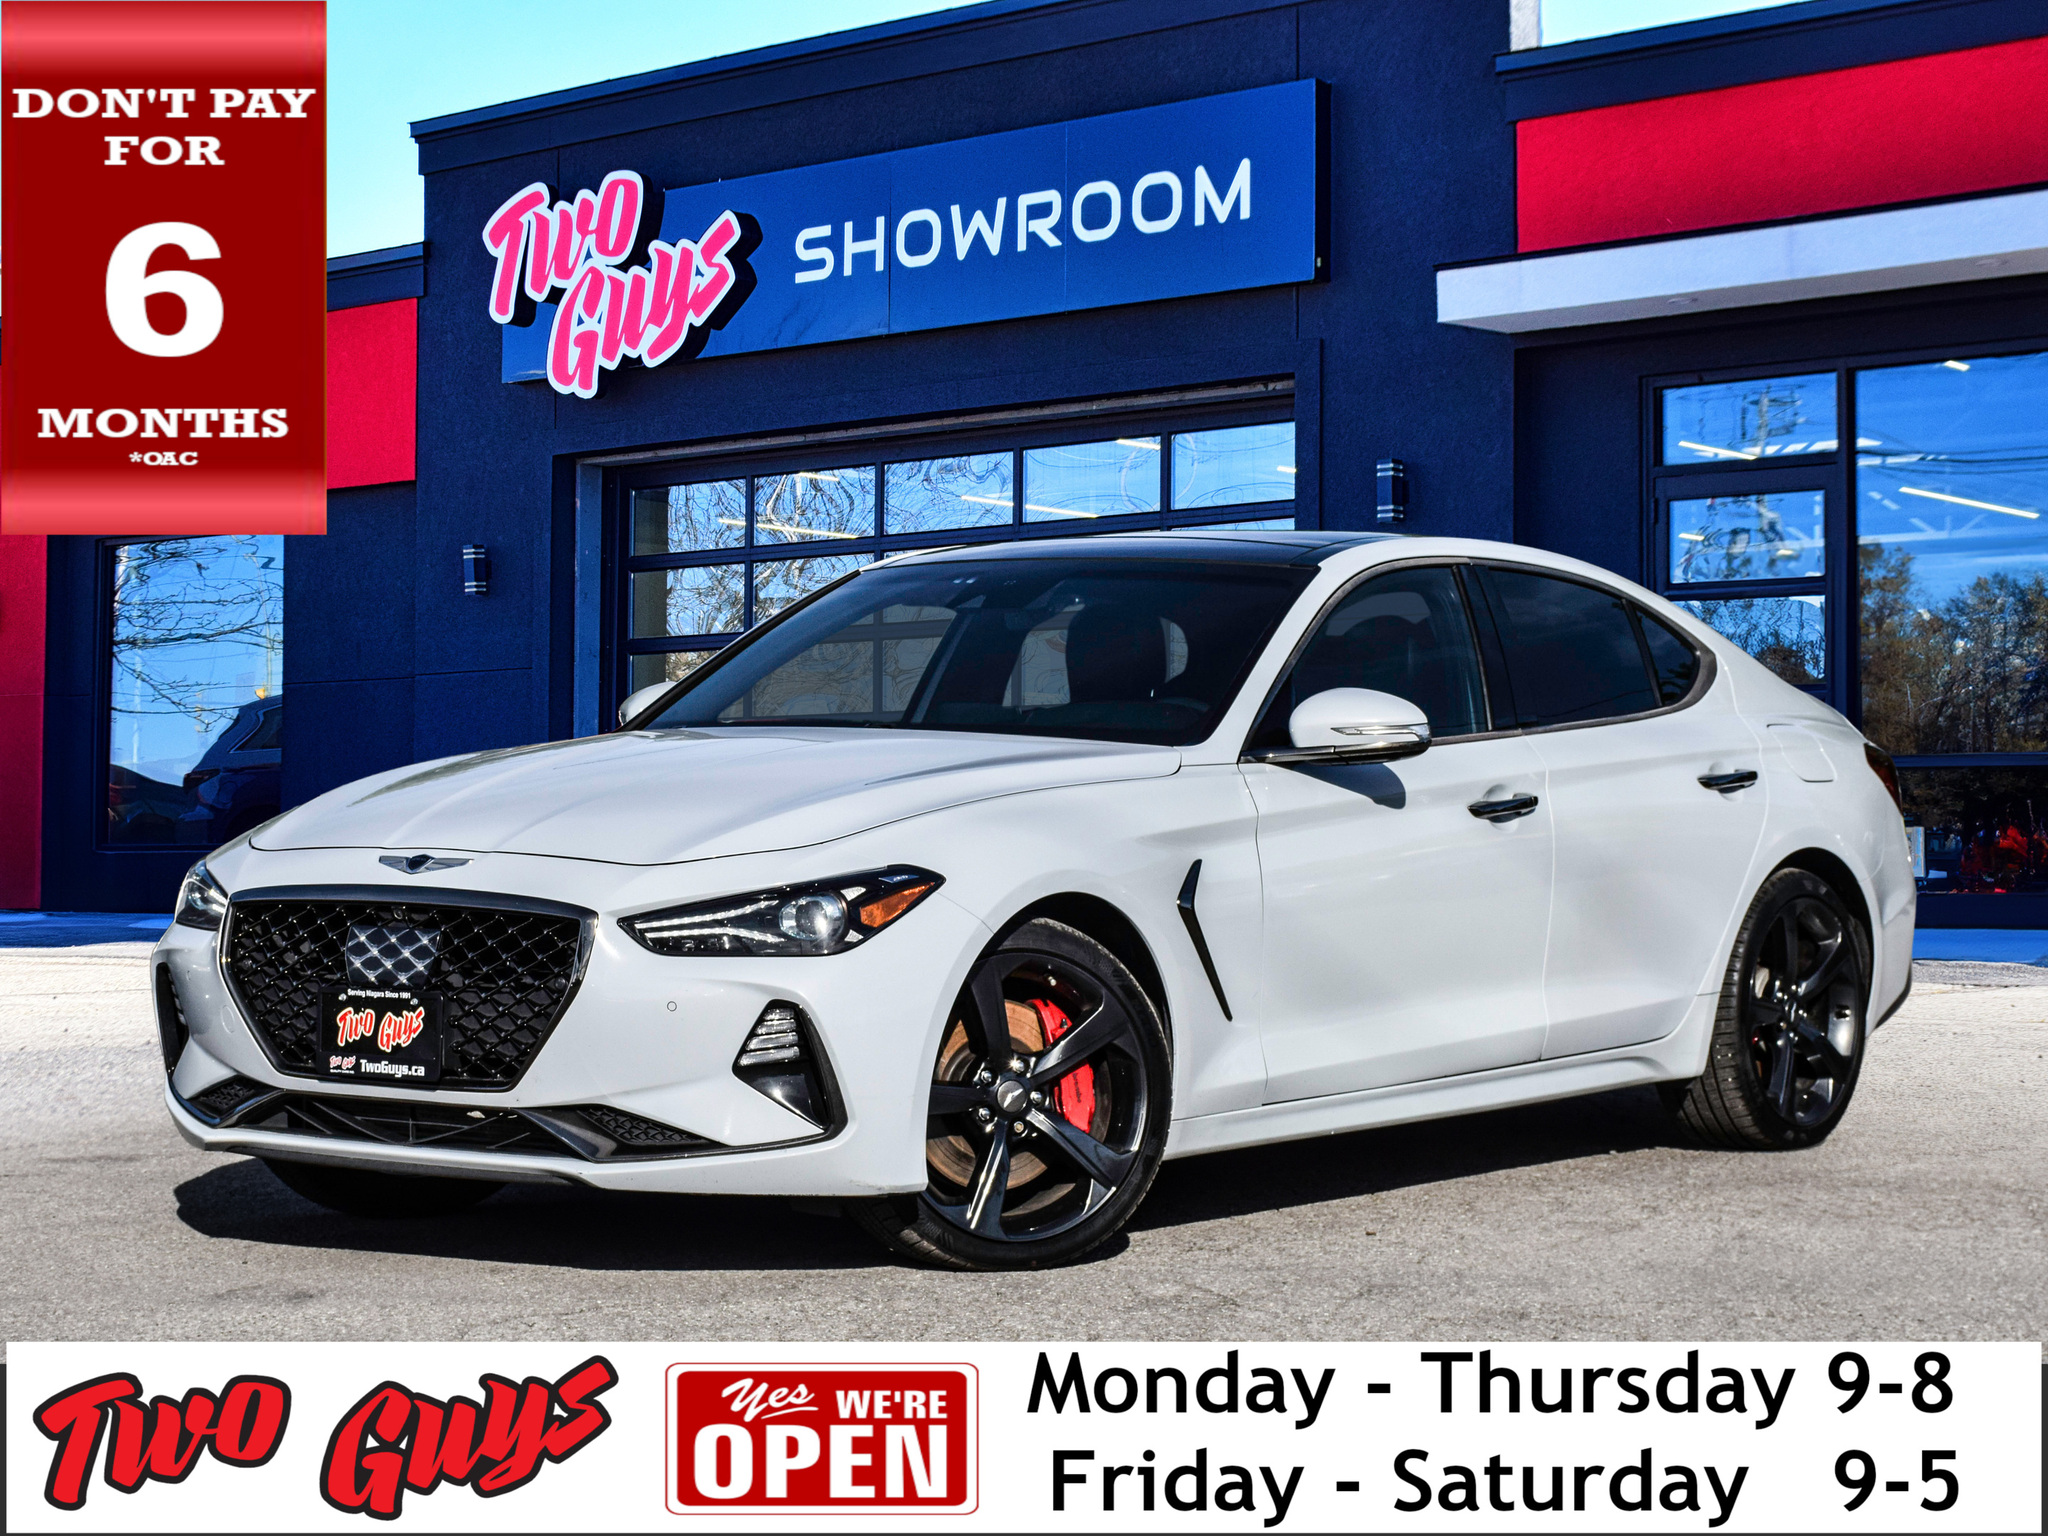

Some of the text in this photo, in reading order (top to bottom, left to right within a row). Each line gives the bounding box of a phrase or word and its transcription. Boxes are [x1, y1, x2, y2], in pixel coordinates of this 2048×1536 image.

[482, 170, 643, 324] Two
[794, 158, 1251, 284] SHOWROOM
[546, 209, 741, 399] Guys
[337, 1006, 425, 1052] Two Guys
[359, 1058, 425, 1078] TwoGuys.ca
